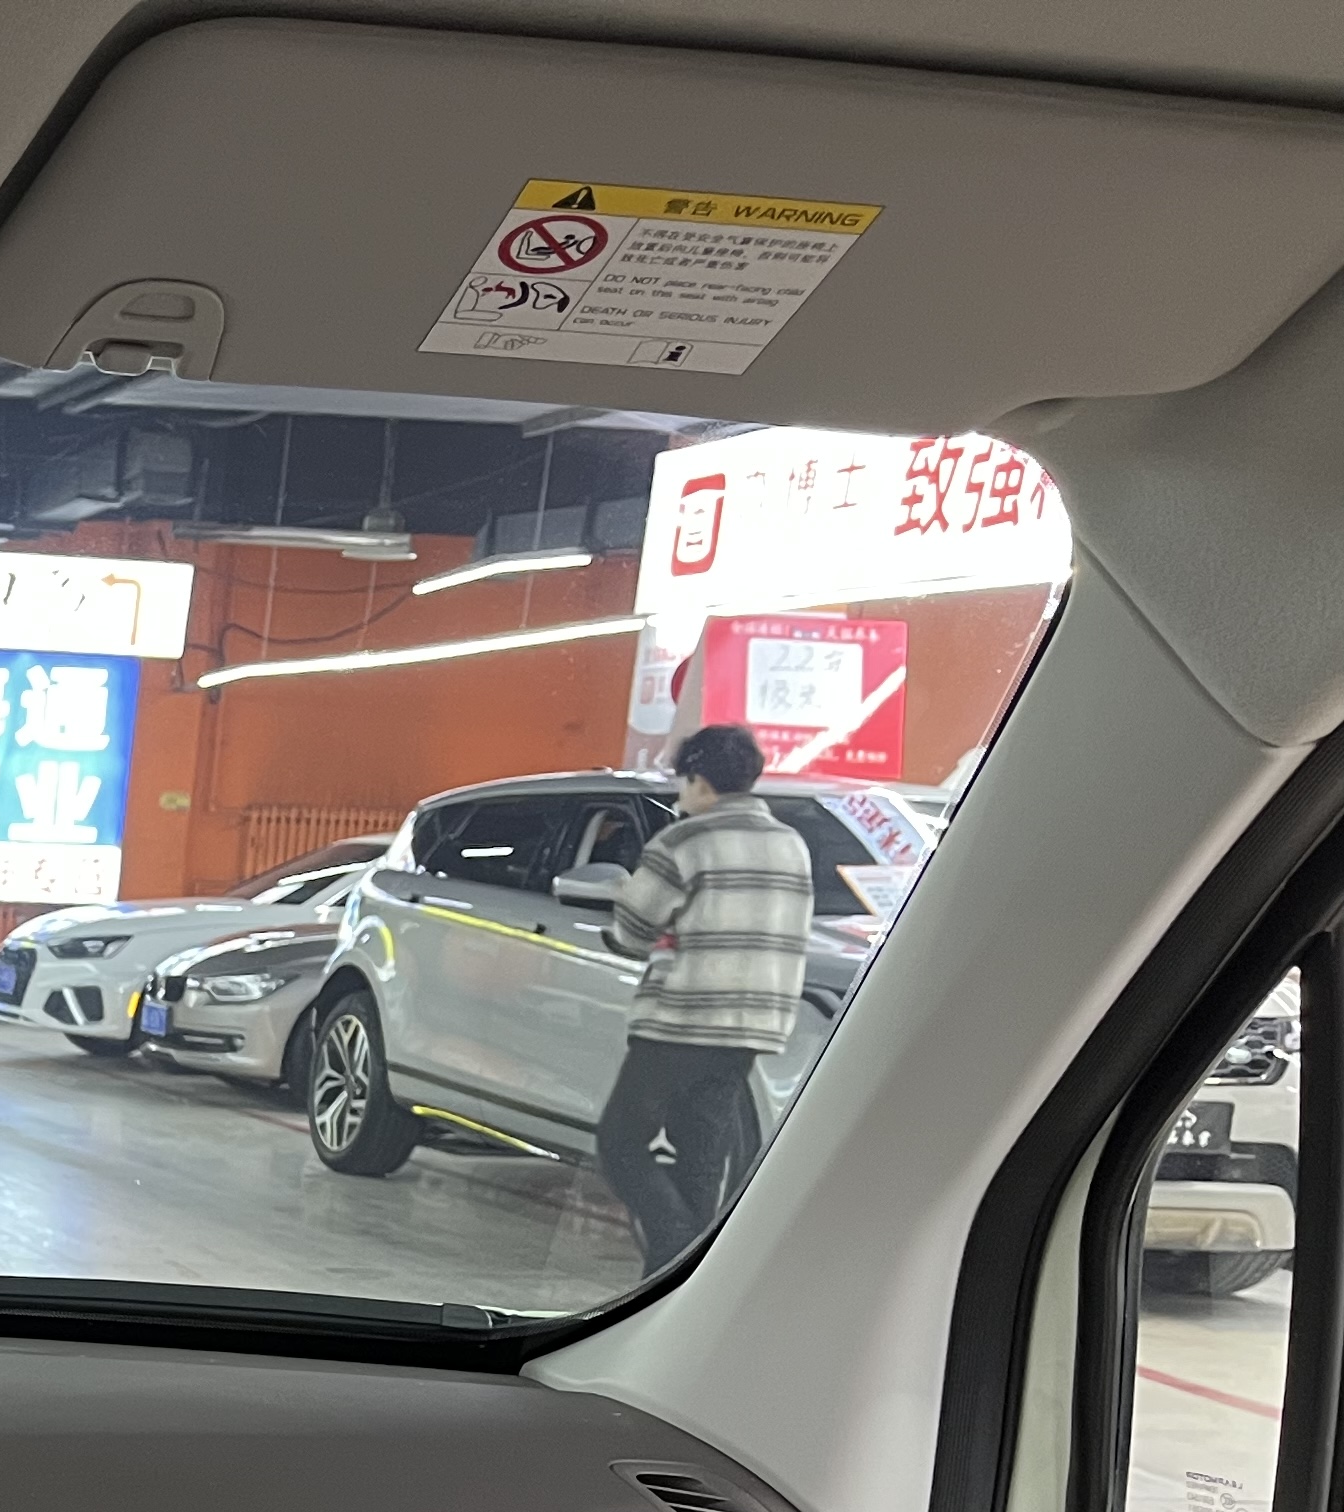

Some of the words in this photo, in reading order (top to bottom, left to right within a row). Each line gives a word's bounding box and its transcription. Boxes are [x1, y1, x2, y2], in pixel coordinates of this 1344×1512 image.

[664, 198, 717, 217] 警告
[734, 205, 864, 226] WARNING
[604, 273, 627, 283] DO
[631, 276, 662, 285] NOT
[663, 280, 697, 288] place
[597, 286, 624, 295] seat
[629, 288, 646, 296] on
[652, 289, 673, 298] this
[679, 292, 707, 300] seat
[580, 305, 628, 316] DEATH
[633, 309, 655, 318] OR
[658, 311, 719, 323] SERIOUS
[723, 316, 773, 326] INJURY
[599, 318, 634, 327] occur
[894, 436, 1054, 537] 致强
